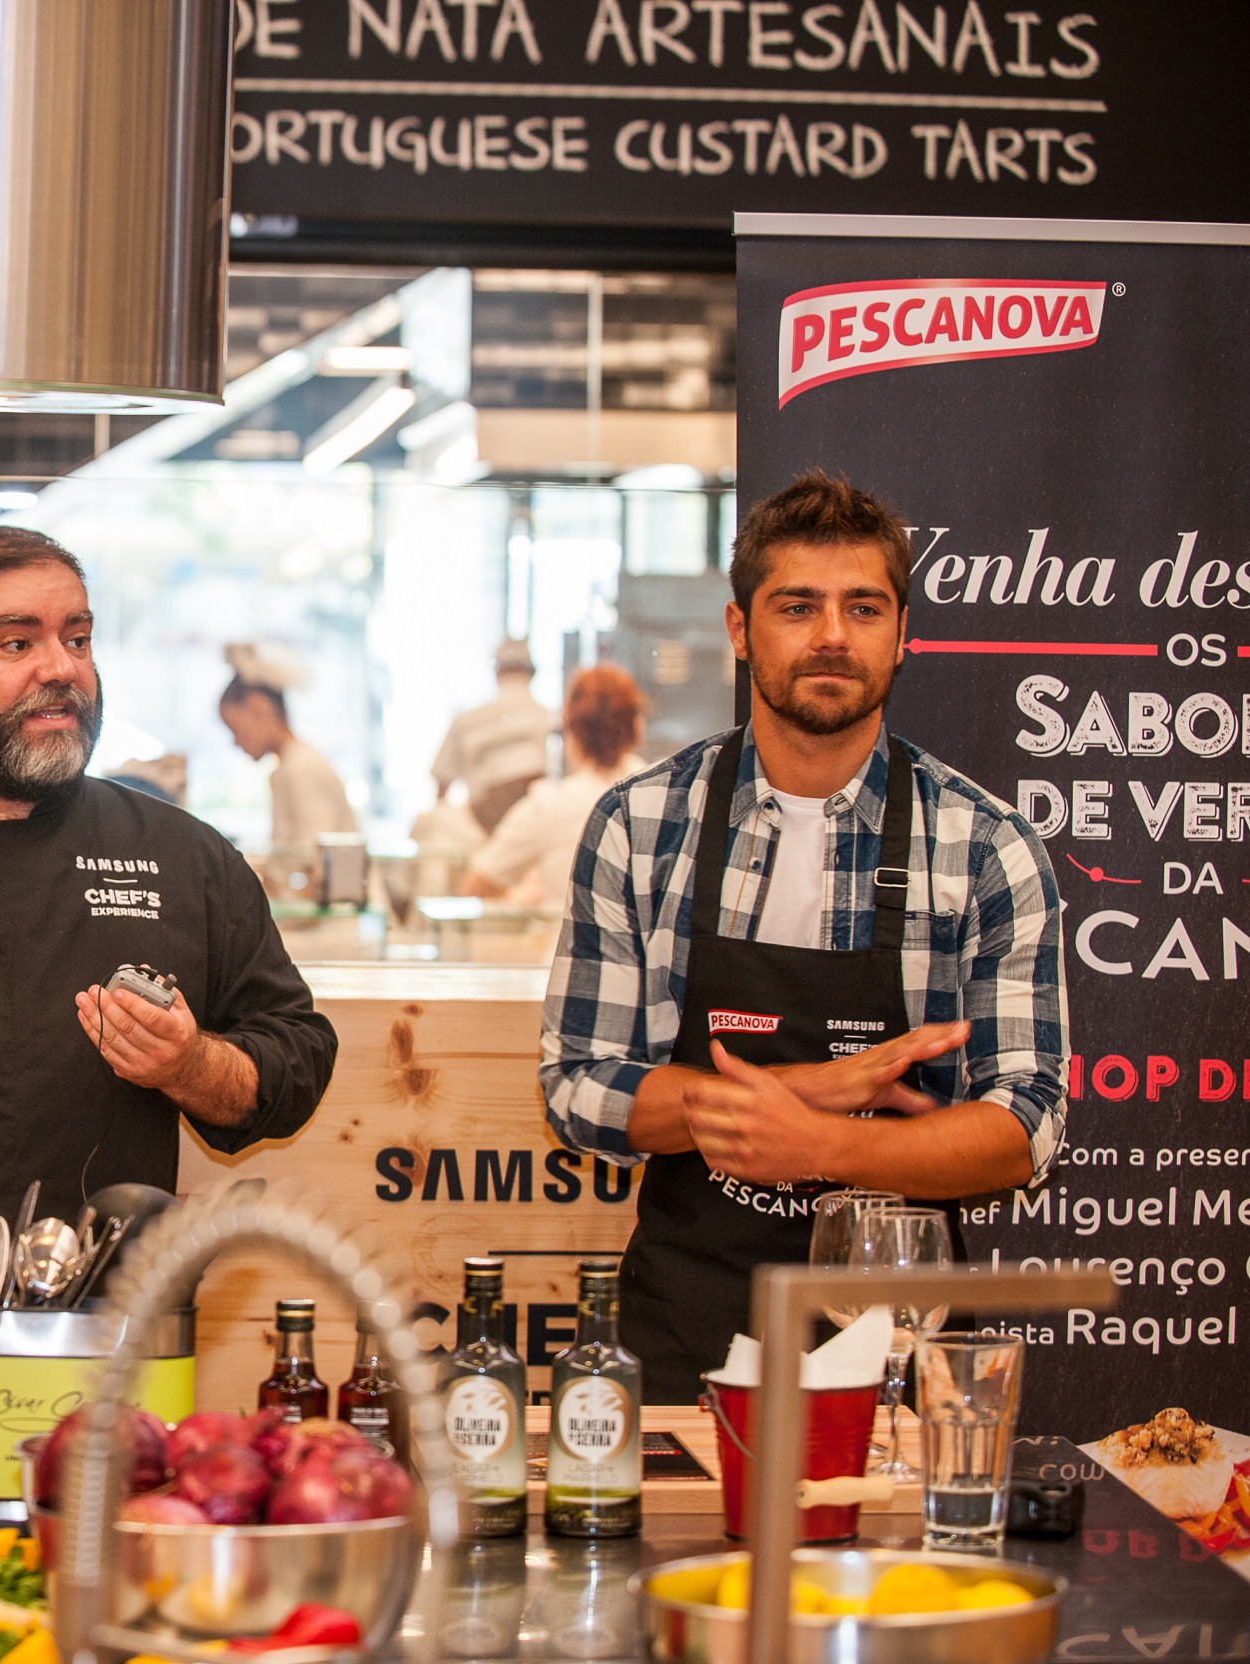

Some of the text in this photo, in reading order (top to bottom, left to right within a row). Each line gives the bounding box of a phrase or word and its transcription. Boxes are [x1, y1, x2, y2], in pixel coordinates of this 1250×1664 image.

[349, 0, 542, 65] NATA
[586, 0, 1100, 79] ARTESANAIS
[614, 113, 889, 178] CUSTARD
[911, 118, 1098, 186] TARTS
[792, 294, 1094, 373] PESCANOVA
[1166, 633, 1227, 667] OS
[1015, 674, 1250, 758] SABO
[1017, 779, 1113, 841] DE
[75, 855, 159, 875] SAMSUNG
[1163, 862, 1224, 895] DA
[84, 888, 162, 908] CHEF'S
[91, 907, 160, 919] EXPERIENCE
[711, 1014, 774, 1029] PESCANOVA
[826, 1019, 886, 1031] SAMSUNG
[1199, 1059, 1250, 1102] D
[1129, 1149, 1145, 1165] a
[776, 1181, 794, 1193] DA
[1012, 1186, 1177, 1235] Miguel
[1067, 1306, 1236, 1354] Raquel
